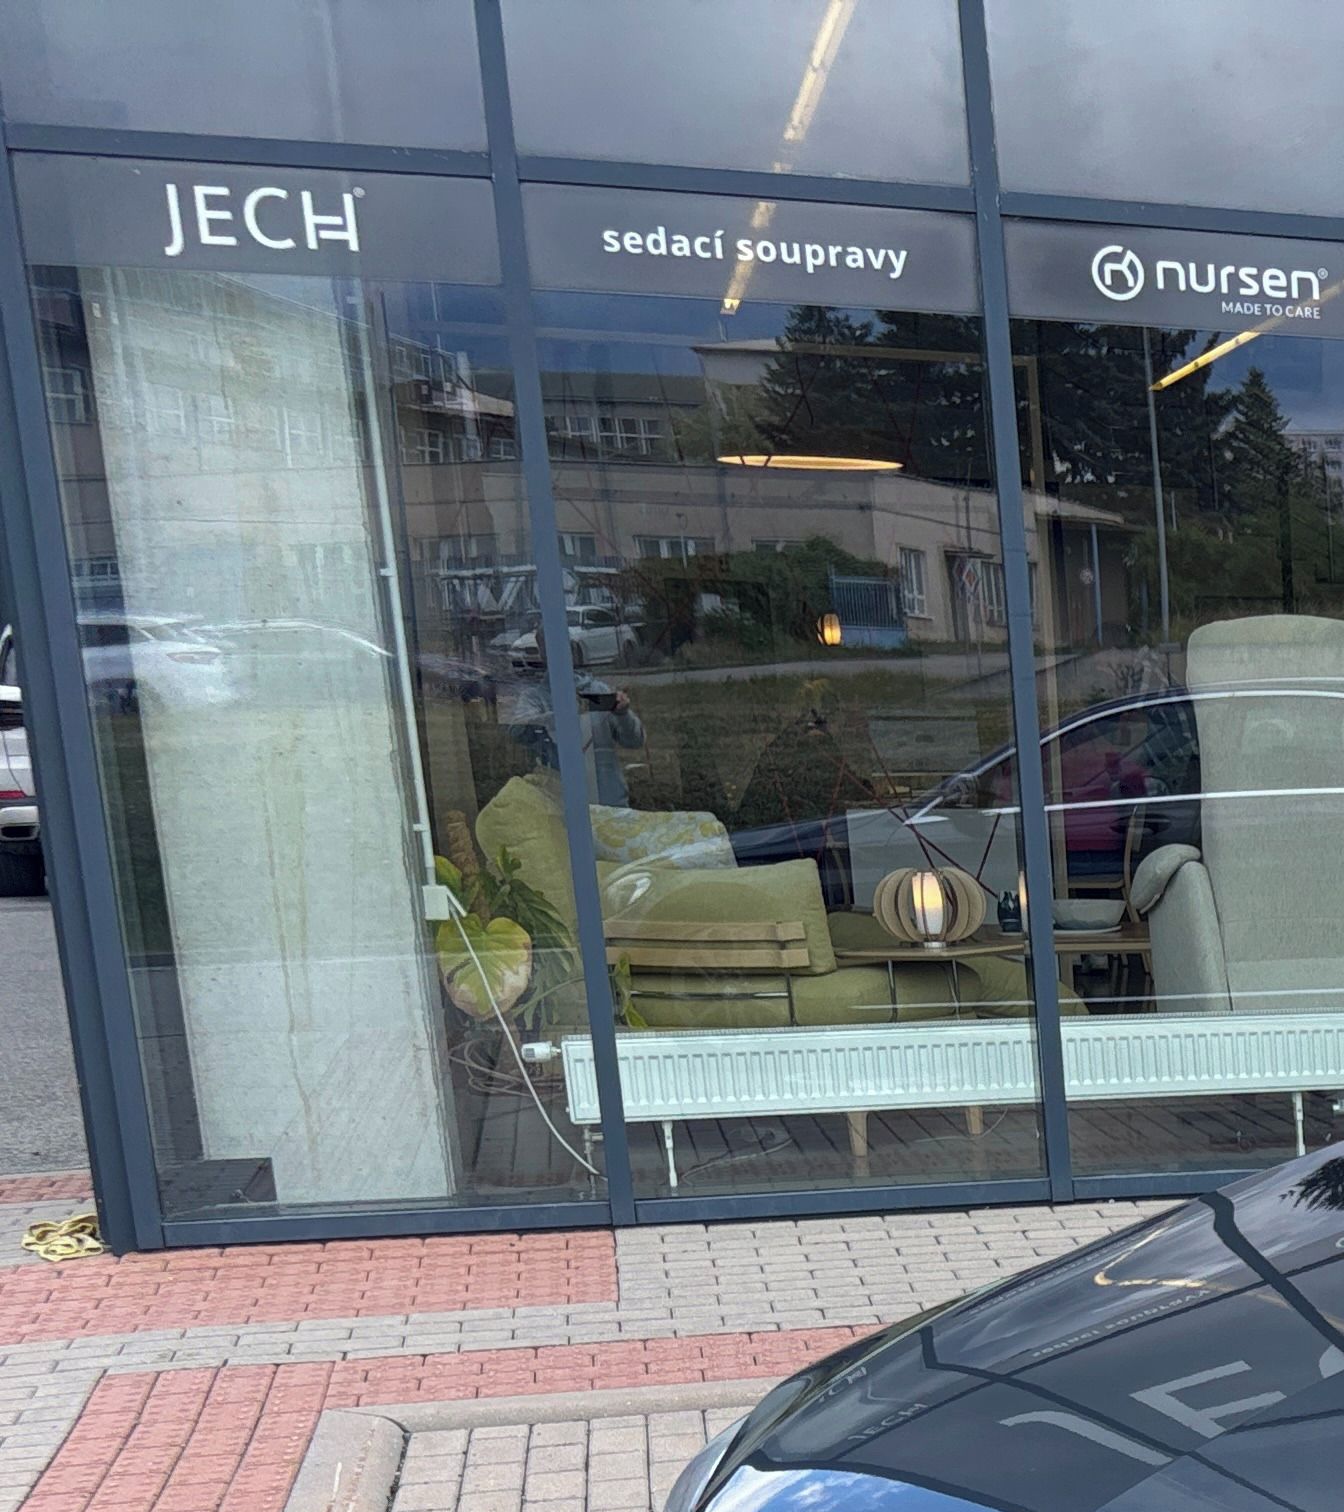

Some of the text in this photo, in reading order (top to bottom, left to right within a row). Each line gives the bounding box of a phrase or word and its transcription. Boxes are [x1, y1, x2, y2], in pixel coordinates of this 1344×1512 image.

[164, 183, 361, 256] JECH
[603, 226, 908, 279] sedací soupravy
[1156, 260, 1320, 301] nursen
[1221, 301, 1321, 320] MADE TO CARE
